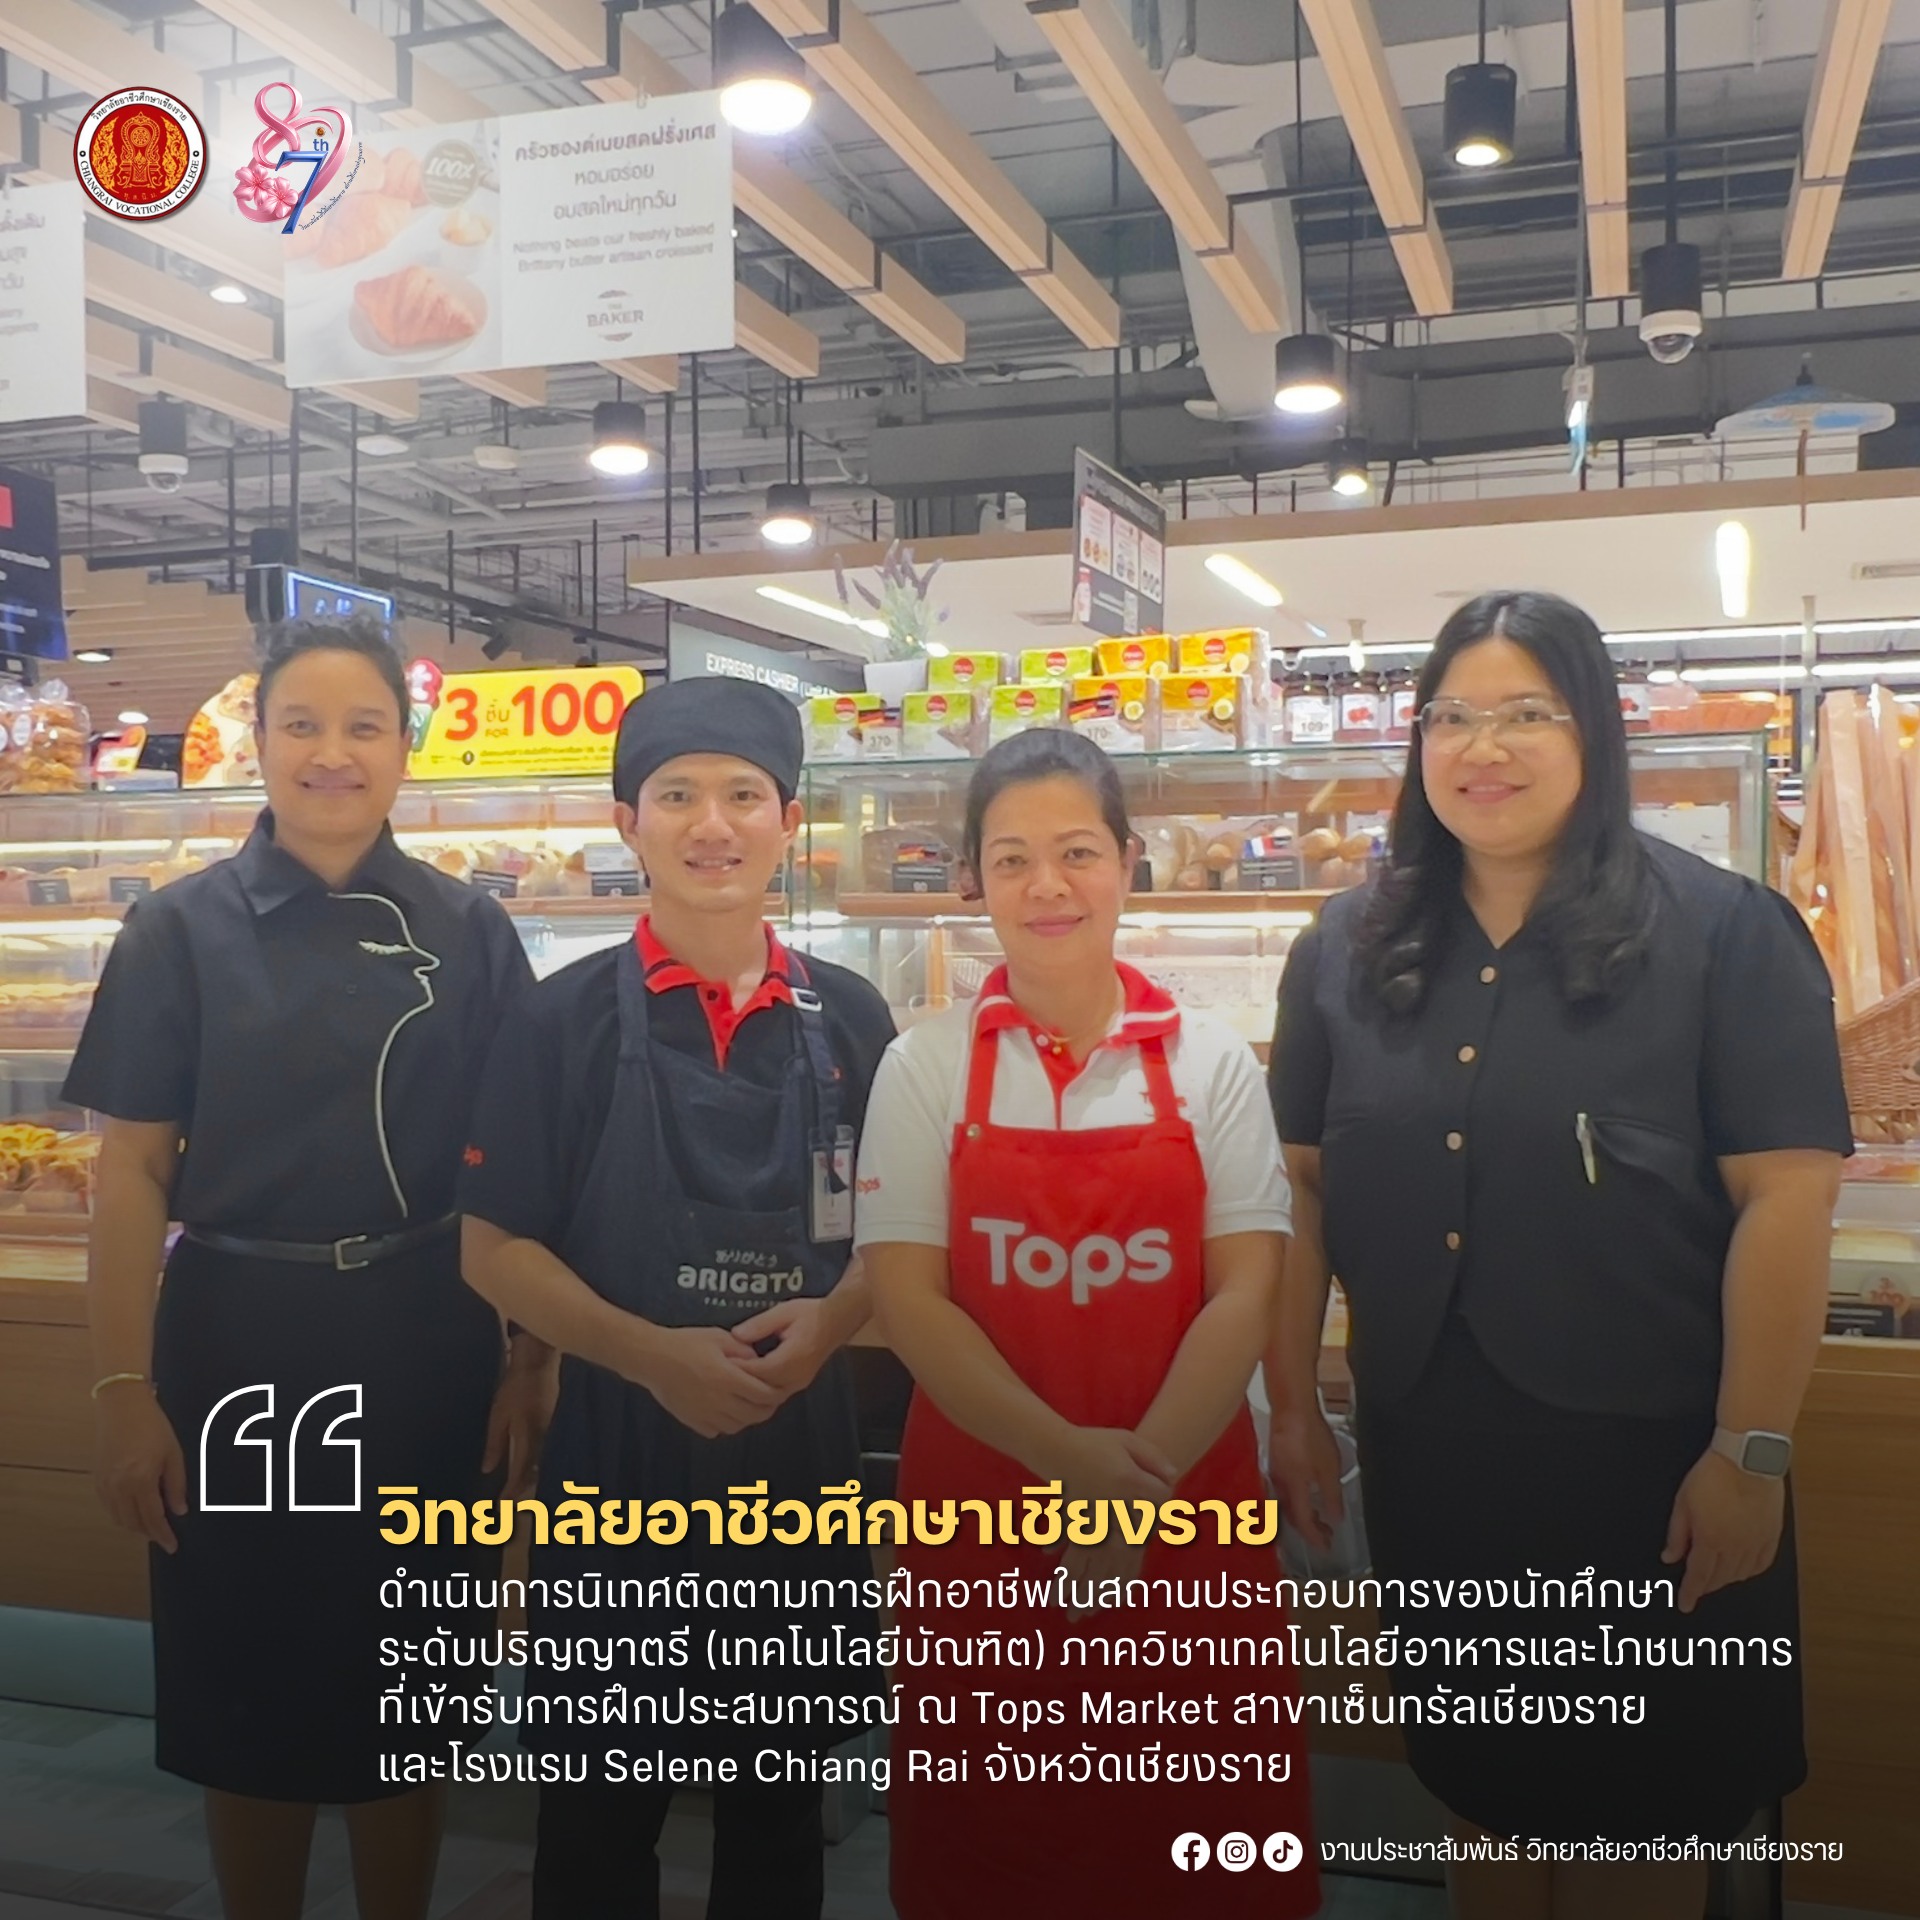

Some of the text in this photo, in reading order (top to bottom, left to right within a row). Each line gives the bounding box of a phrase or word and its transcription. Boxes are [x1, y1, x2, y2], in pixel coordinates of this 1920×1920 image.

[586, 309, 645, 327] BAKER
[705, 652, 755, 681] EXPRESS
[756, 666, 799, 695] CASHIER
[445, 680, 624, 741] 3 100
[971, 1217, 1173, 1305] Tops
